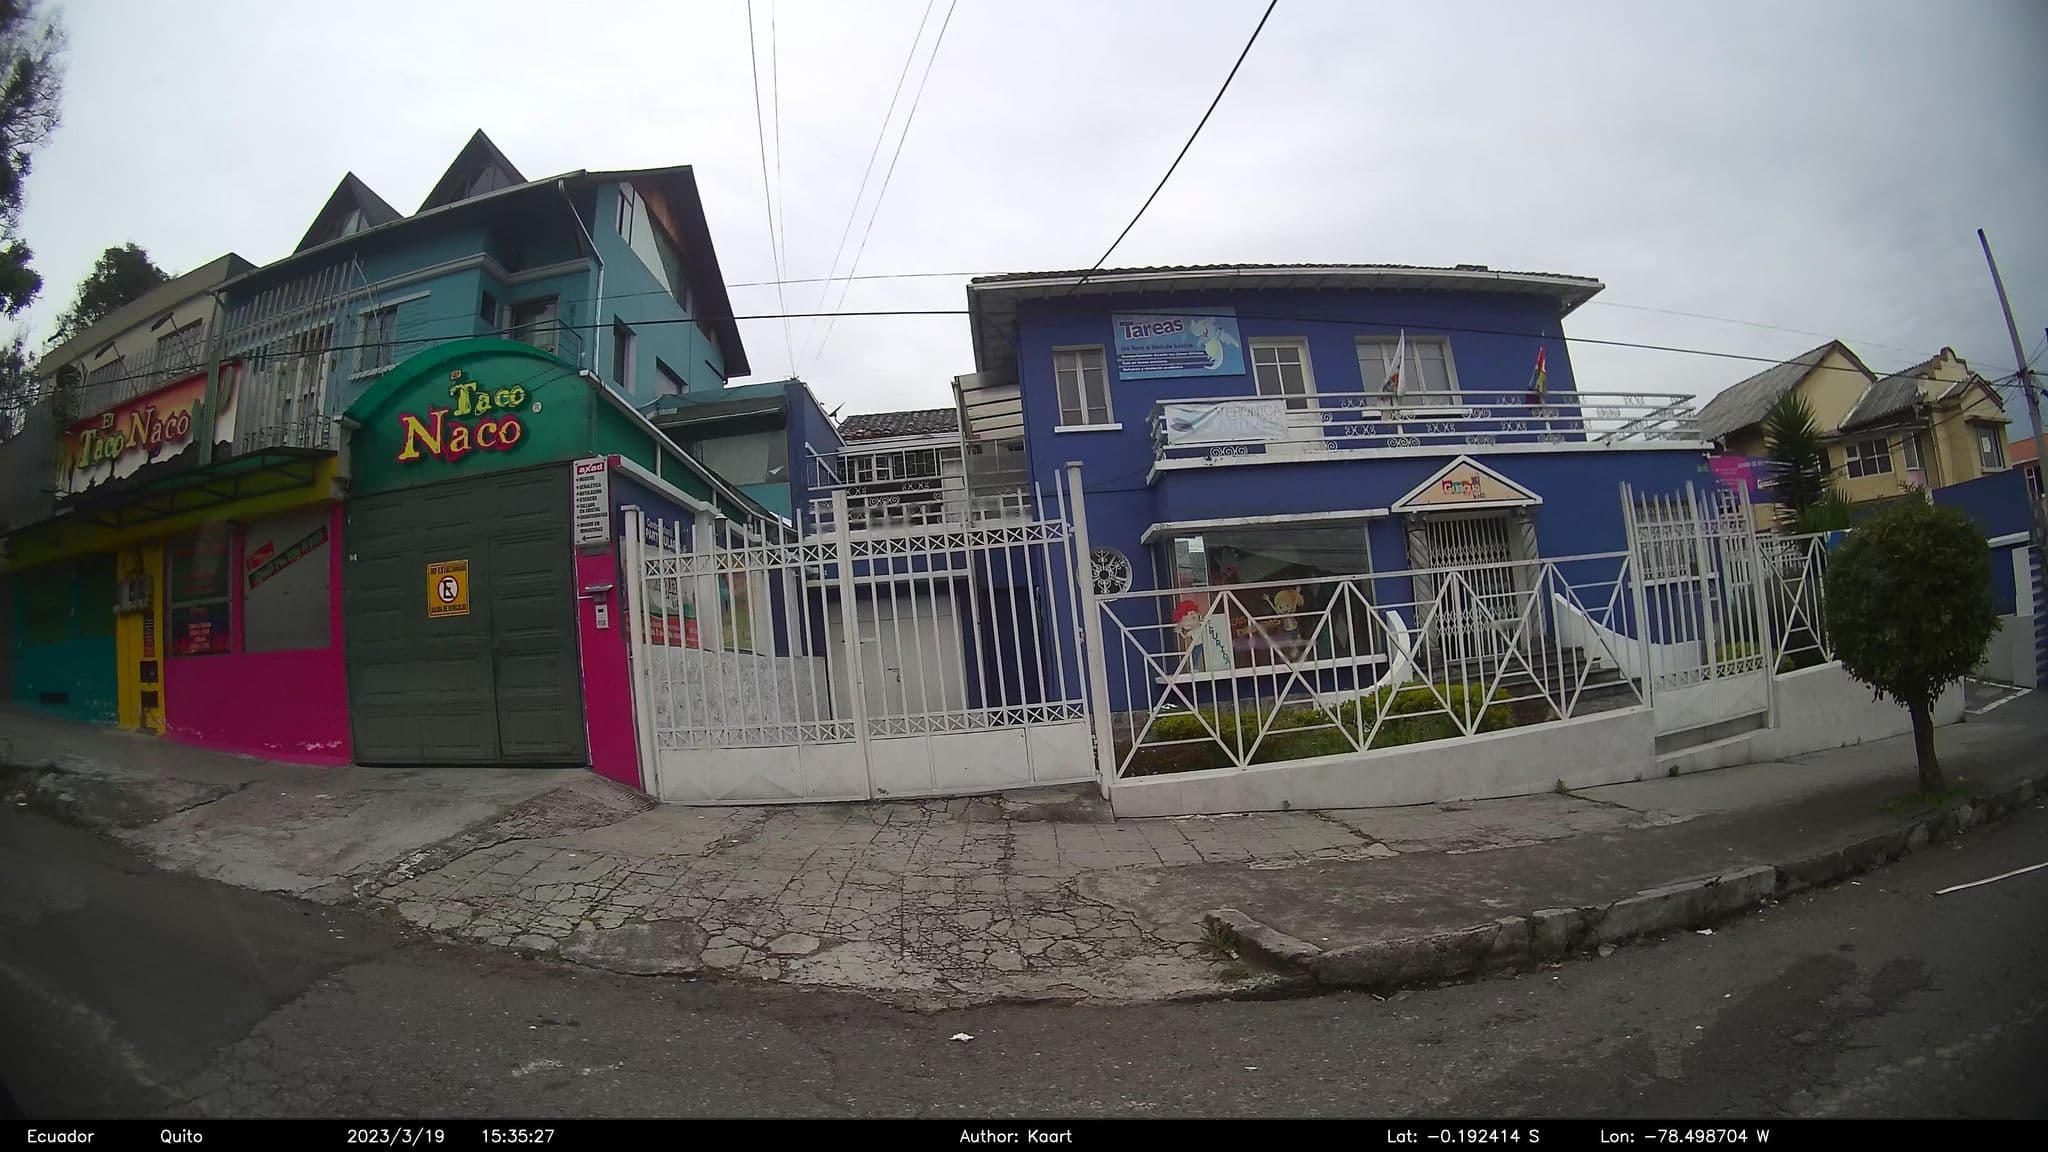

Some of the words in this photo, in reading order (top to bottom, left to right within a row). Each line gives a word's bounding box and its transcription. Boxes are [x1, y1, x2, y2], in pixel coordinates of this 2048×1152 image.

[1120, 319, 1184, 339] Tareas
[450, 382, 526, 417] Taco
[102, 412, 114, 430] El
[398, 408, 524, 460] Naco
[78, 427, 125, 469] Taco
[125, 403, 190, 448] Naco
[578, 462, 604, 475] axad
